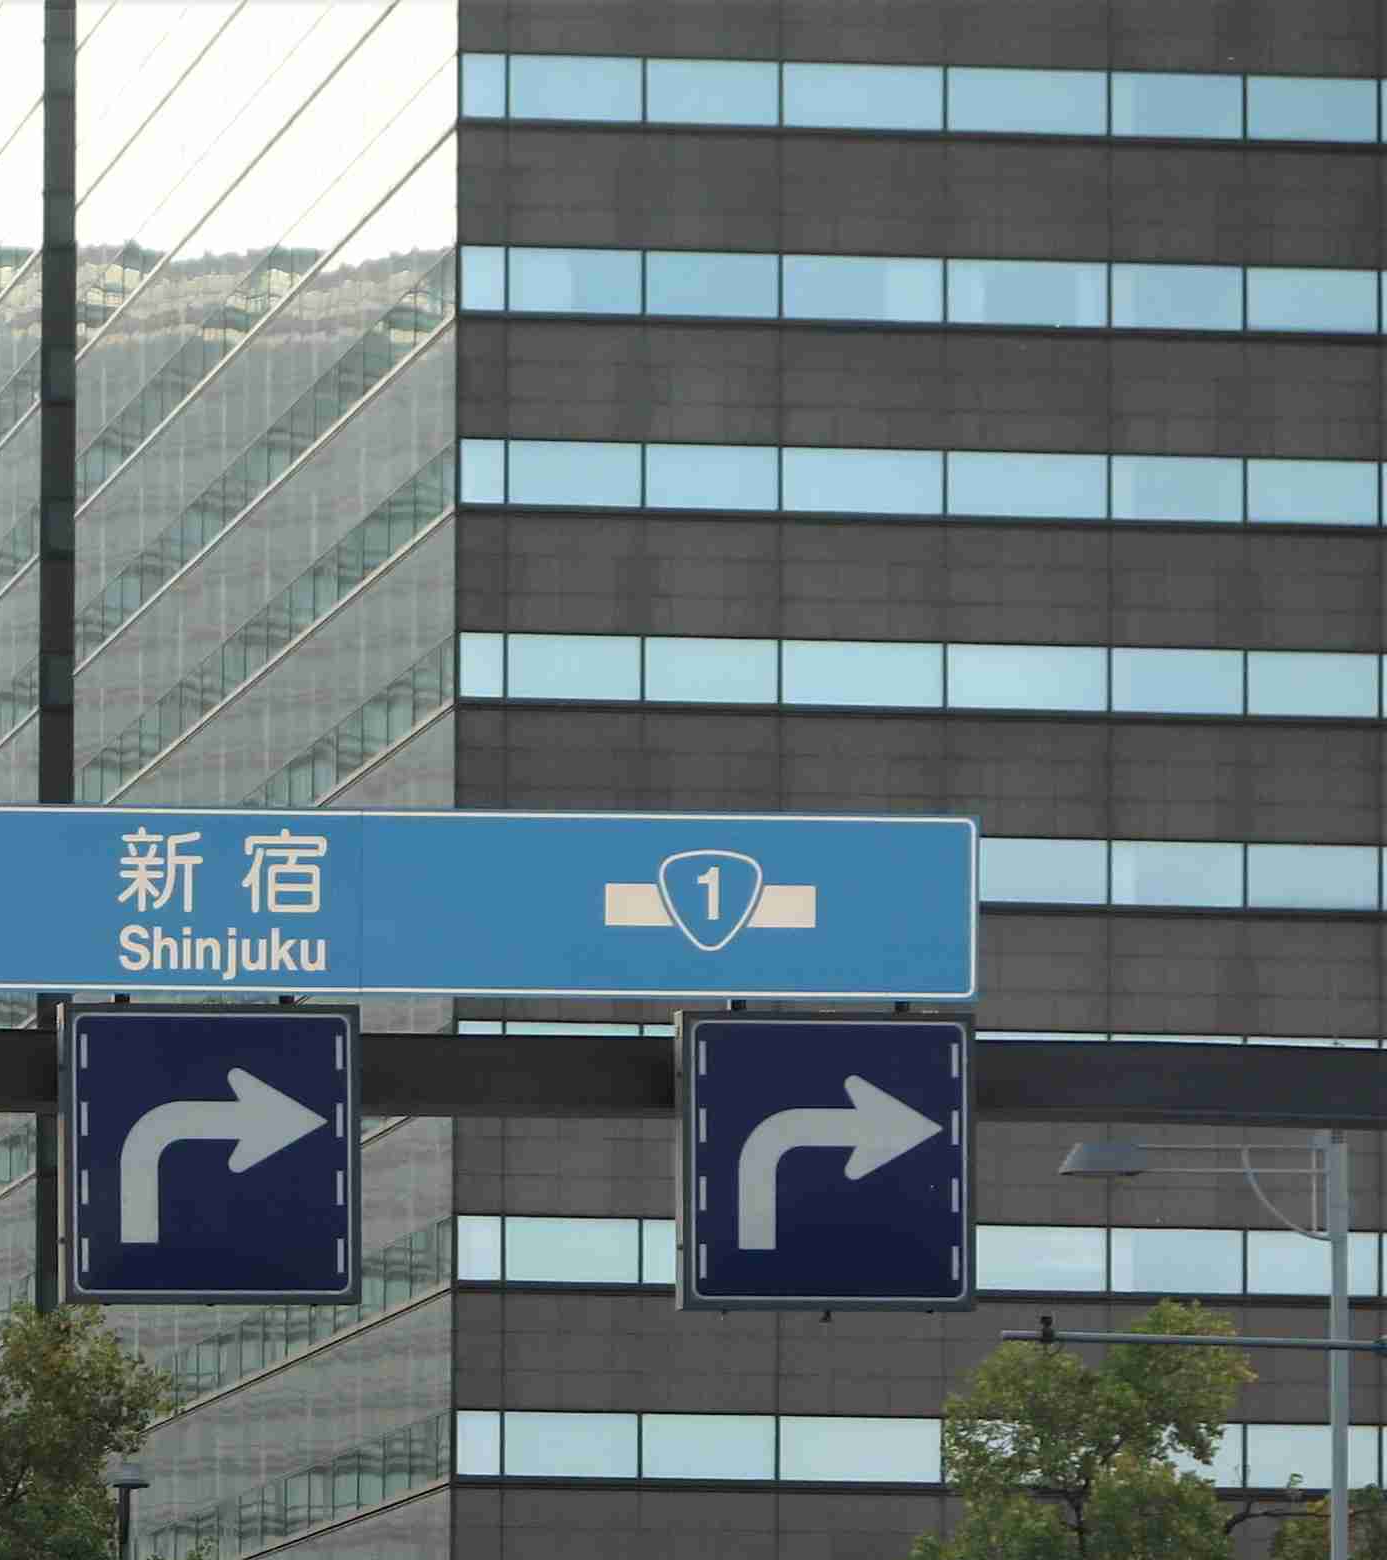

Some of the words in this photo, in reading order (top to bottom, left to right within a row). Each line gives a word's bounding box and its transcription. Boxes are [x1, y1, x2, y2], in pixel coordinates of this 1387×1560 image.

[117, 826, 328, 913] 新宿
[696, 866, 721, 921] 1
[118, 924, 327, 981] Shinjuku
